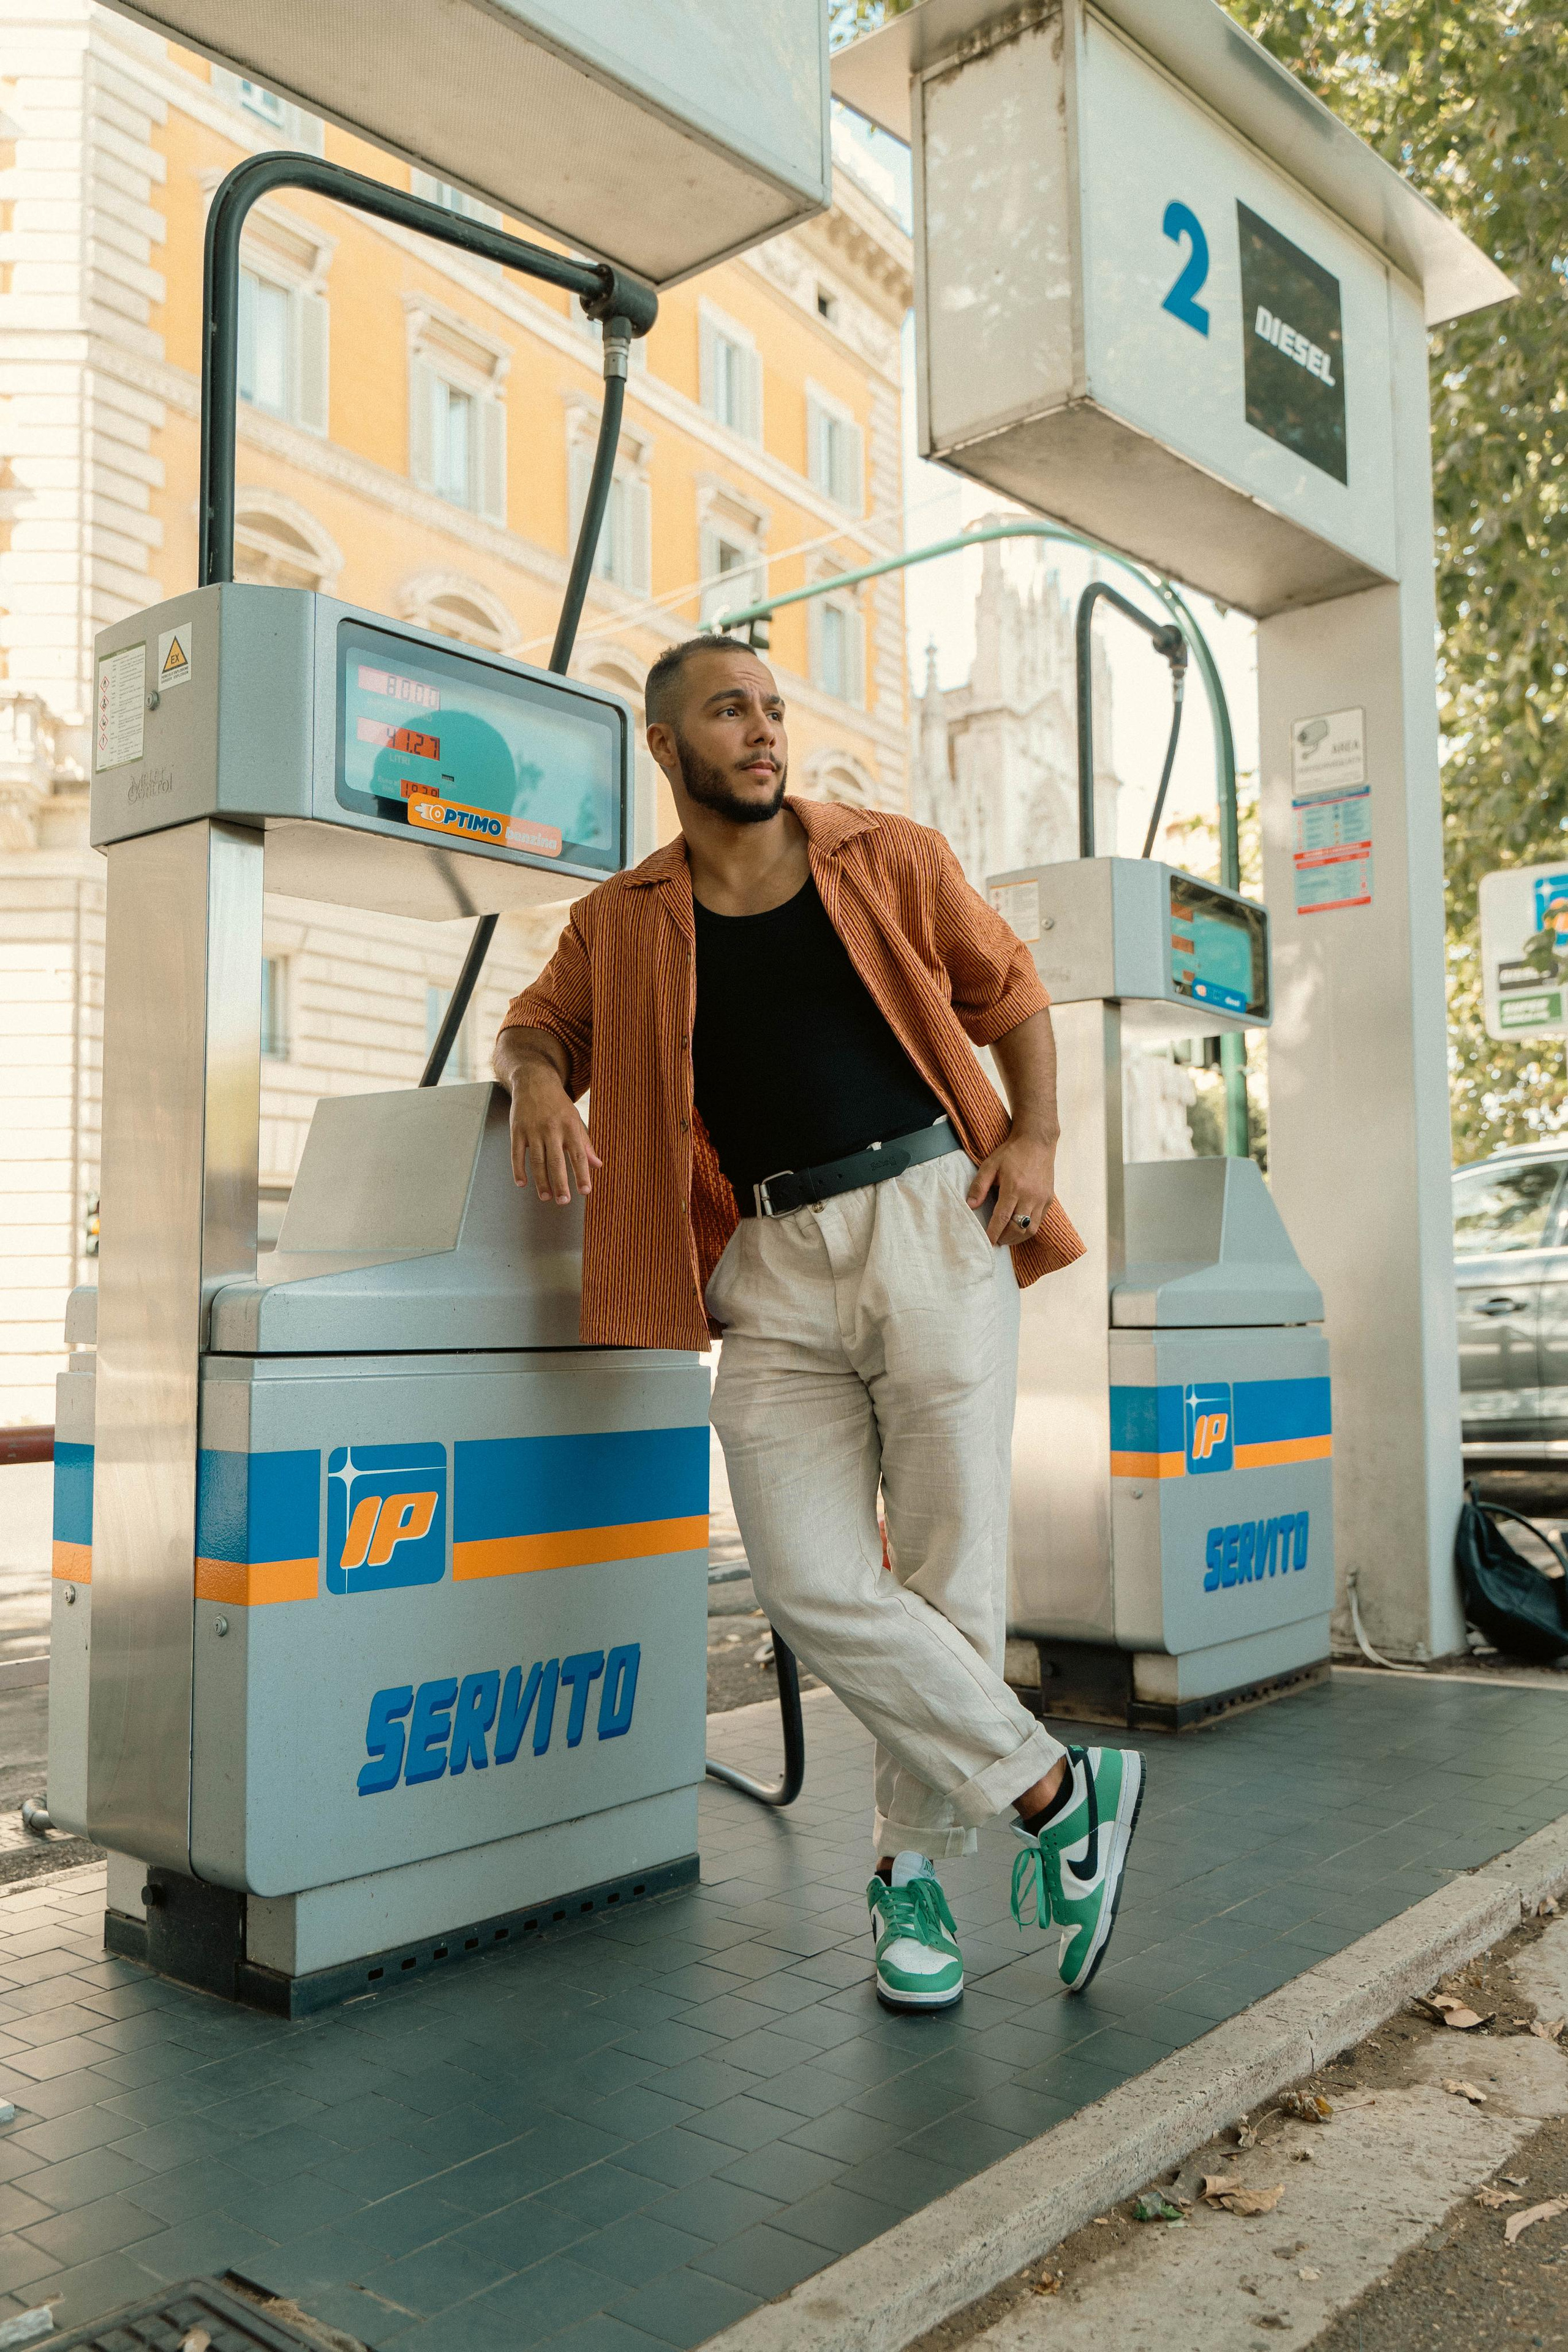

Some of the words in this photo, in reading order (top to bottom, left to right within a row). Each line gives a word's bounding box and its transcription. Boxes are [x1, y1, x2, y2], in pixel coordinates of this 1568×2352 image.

[1161, 200, 1209, 339] 2
[1254, 304, 1336, 388] DIESEL
[171, 654, 180, 665] EX
[387, 728, 437, 759] 41.27
[429, 804, 502, 837] OPTIMO
[505, 826, 557, 850] benzina
[1192, 1412, 1229, 1460] IP
[340, 1491, 439, 1570] IP
[1204, 1510, 1310, 1593] SERVITO
[356, 1643, 641, 1796] SERVITO
